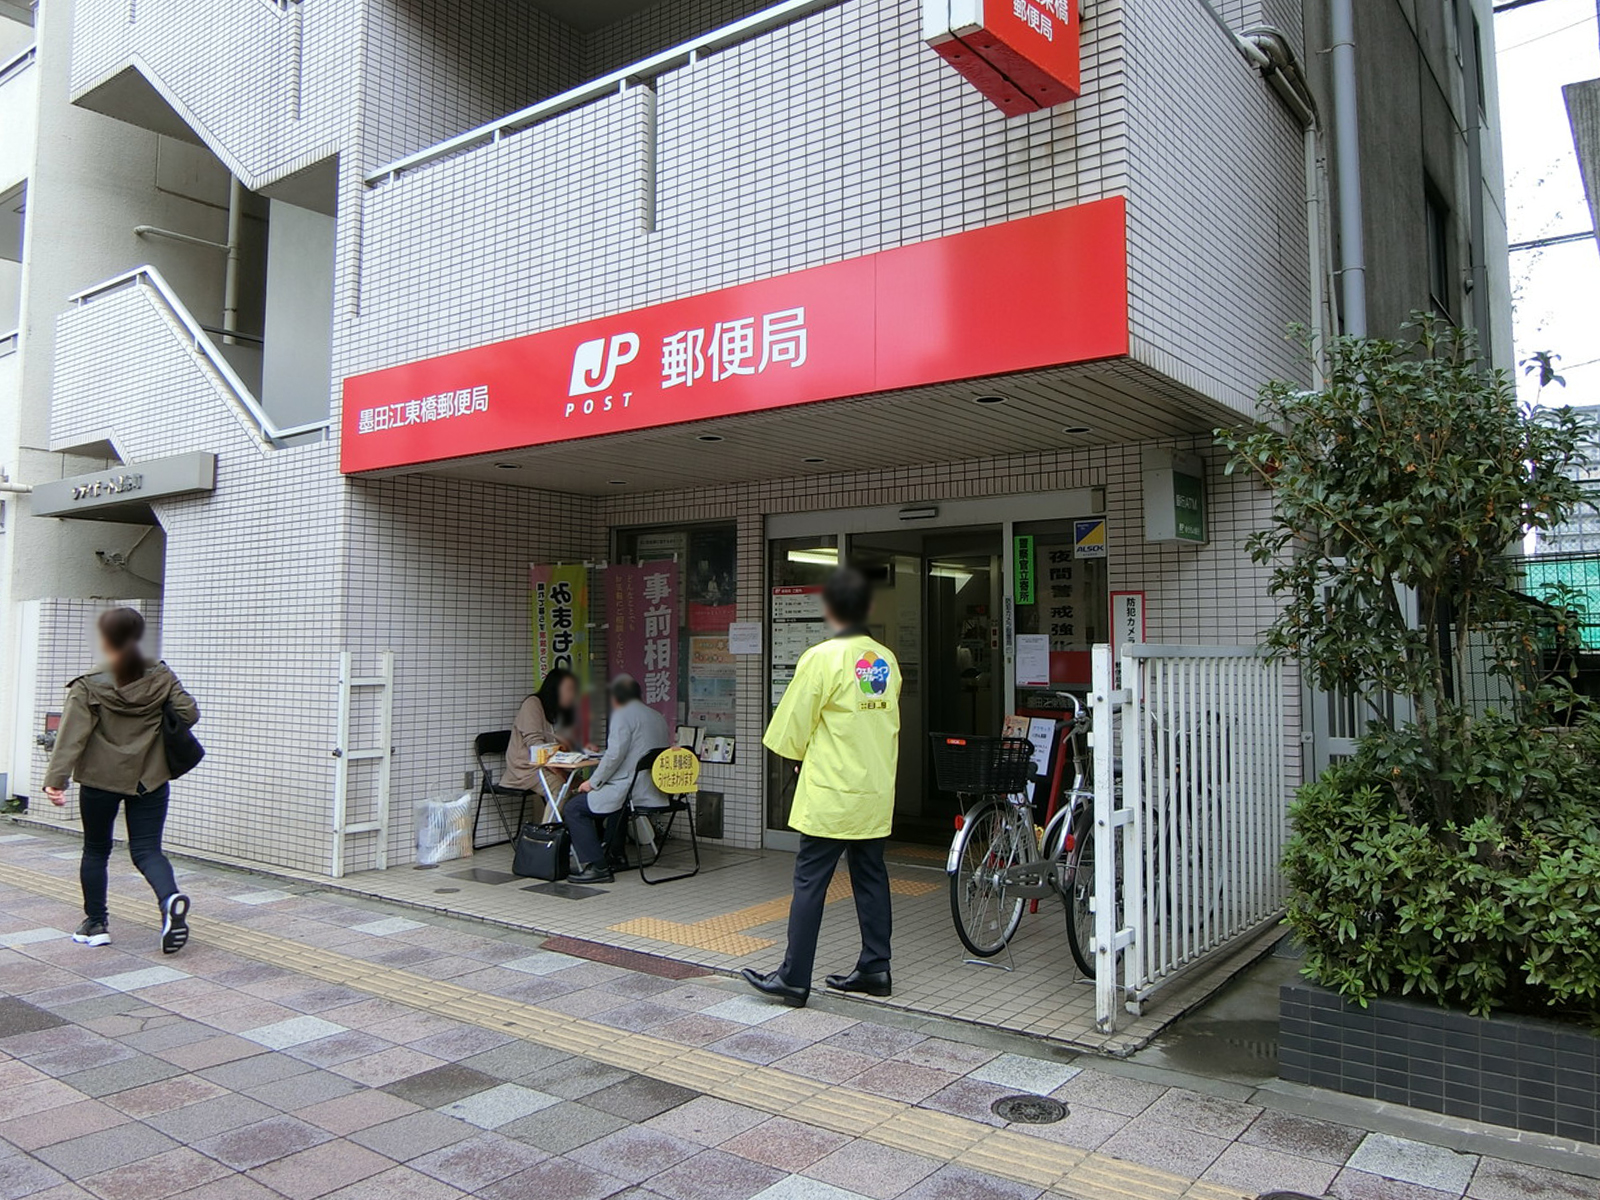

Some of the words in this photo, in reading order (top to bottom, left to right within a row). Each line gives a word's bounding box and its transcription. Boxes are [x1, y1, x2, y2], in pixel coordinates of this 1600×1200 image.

[1012, 0, 1053, 42] 郵便局
[661, 306, 808, 390] 郵便局
[358, 385, 489, 434] 墨田江東橋郵便局
[565, 392, 634, 418] POST
[1076, 544, 1104, 553] ALSOK
[643, 572, 671, 704] 事前相談
[856, 666, 889, 676] ウェルライフ
